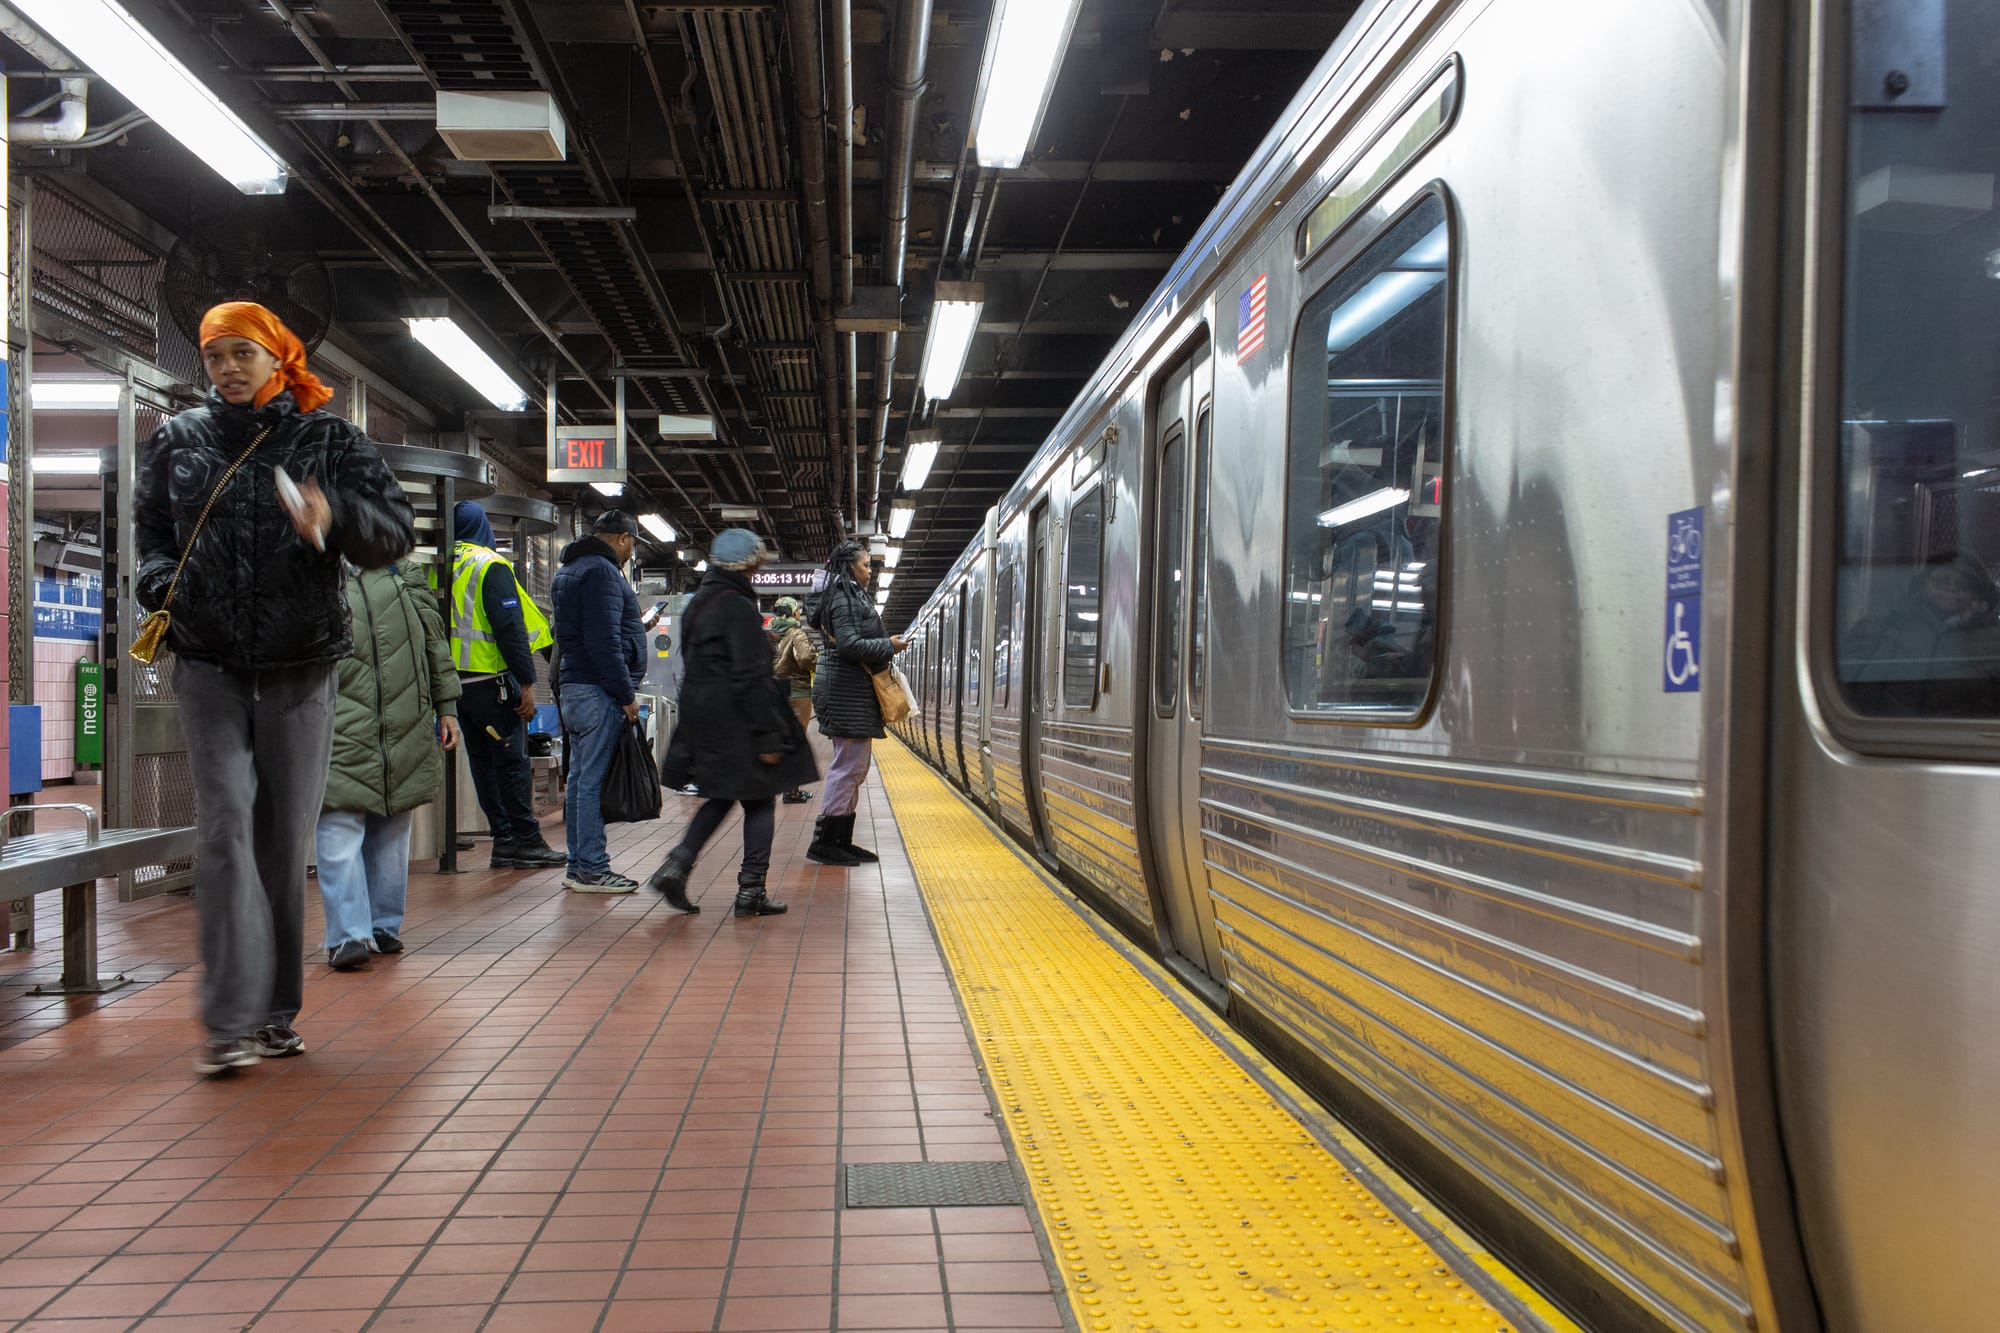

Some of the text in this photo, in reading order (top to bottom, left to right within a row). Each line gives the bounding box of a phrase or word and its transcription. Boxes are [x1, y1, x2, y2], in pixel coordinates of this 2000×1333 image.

[567, 439, 606, 468] EXIT
[81, 666, 98, 674] FREE
[81, 683, 97, 735] metro
